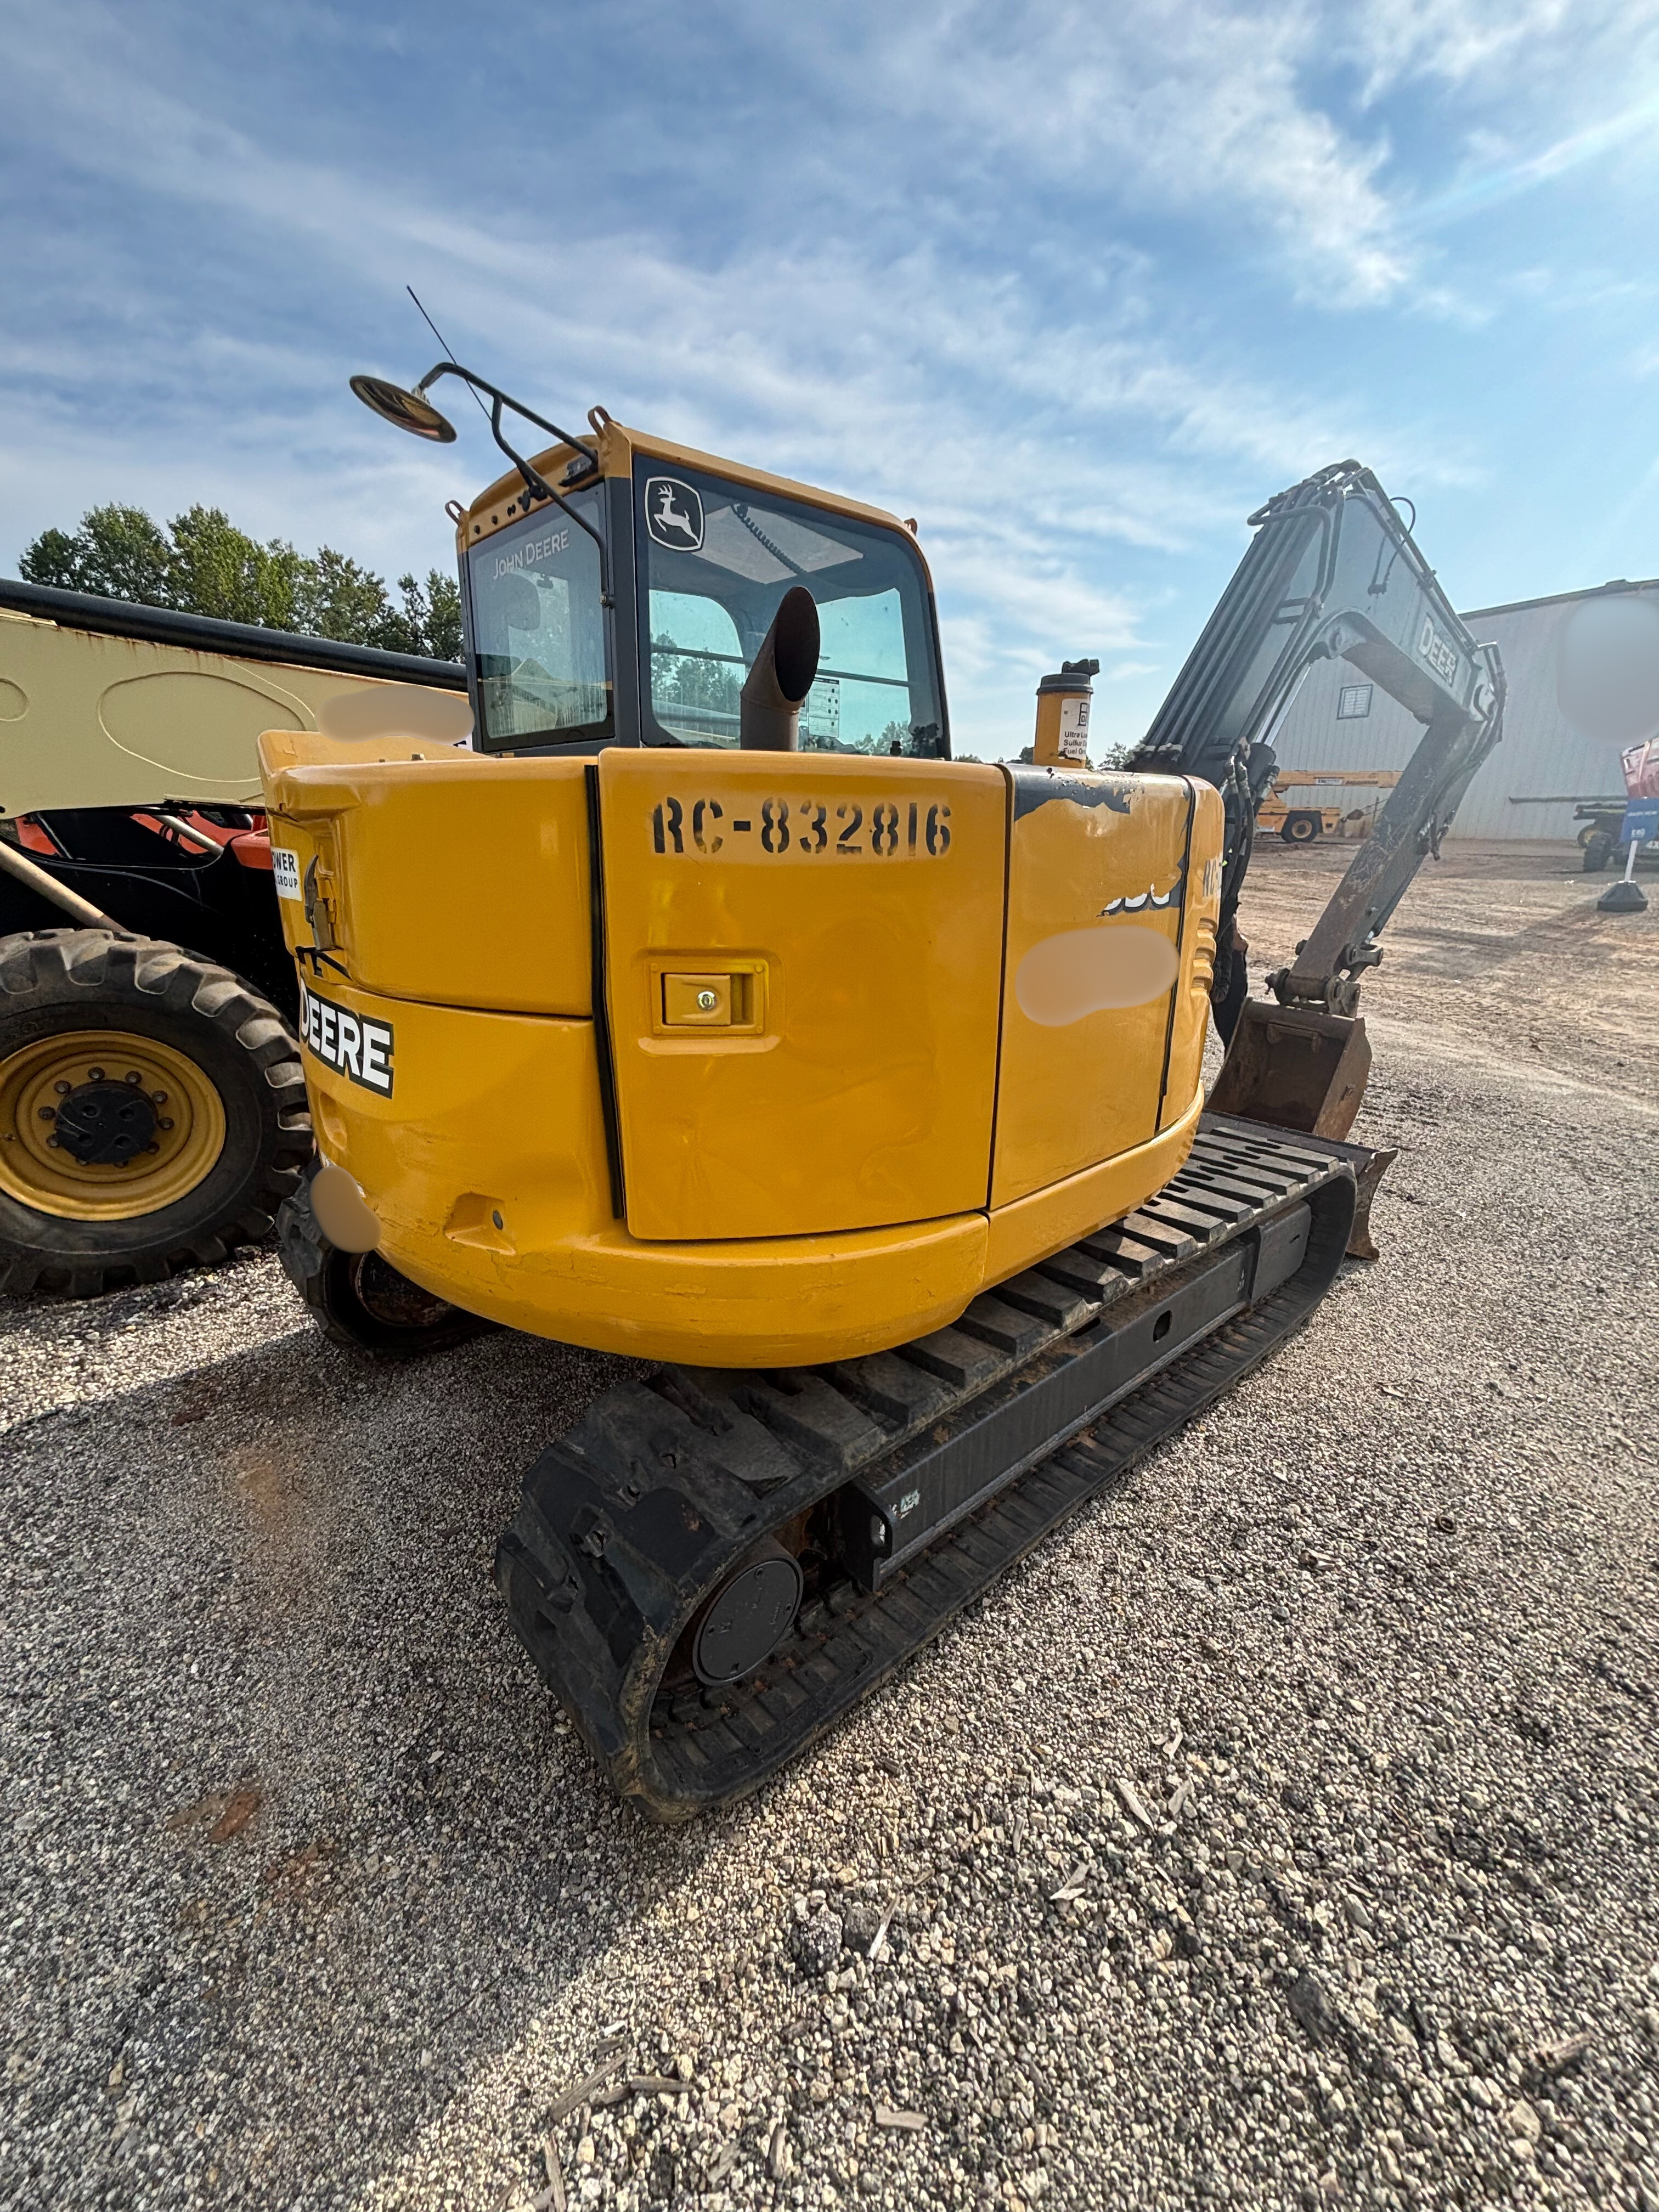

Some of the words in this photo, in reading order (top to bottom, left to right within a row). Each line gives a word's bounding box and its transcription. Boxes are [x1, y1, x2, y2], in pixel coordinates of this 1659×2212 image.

[493, 550, 523, 580] JOHN
[525, 528, 570, 565] DEERE
[652, 796, 952, 857] RC-832816
[277, 874, 298, 889] GROUP
[300, 977, 391, 1089] DEERE
